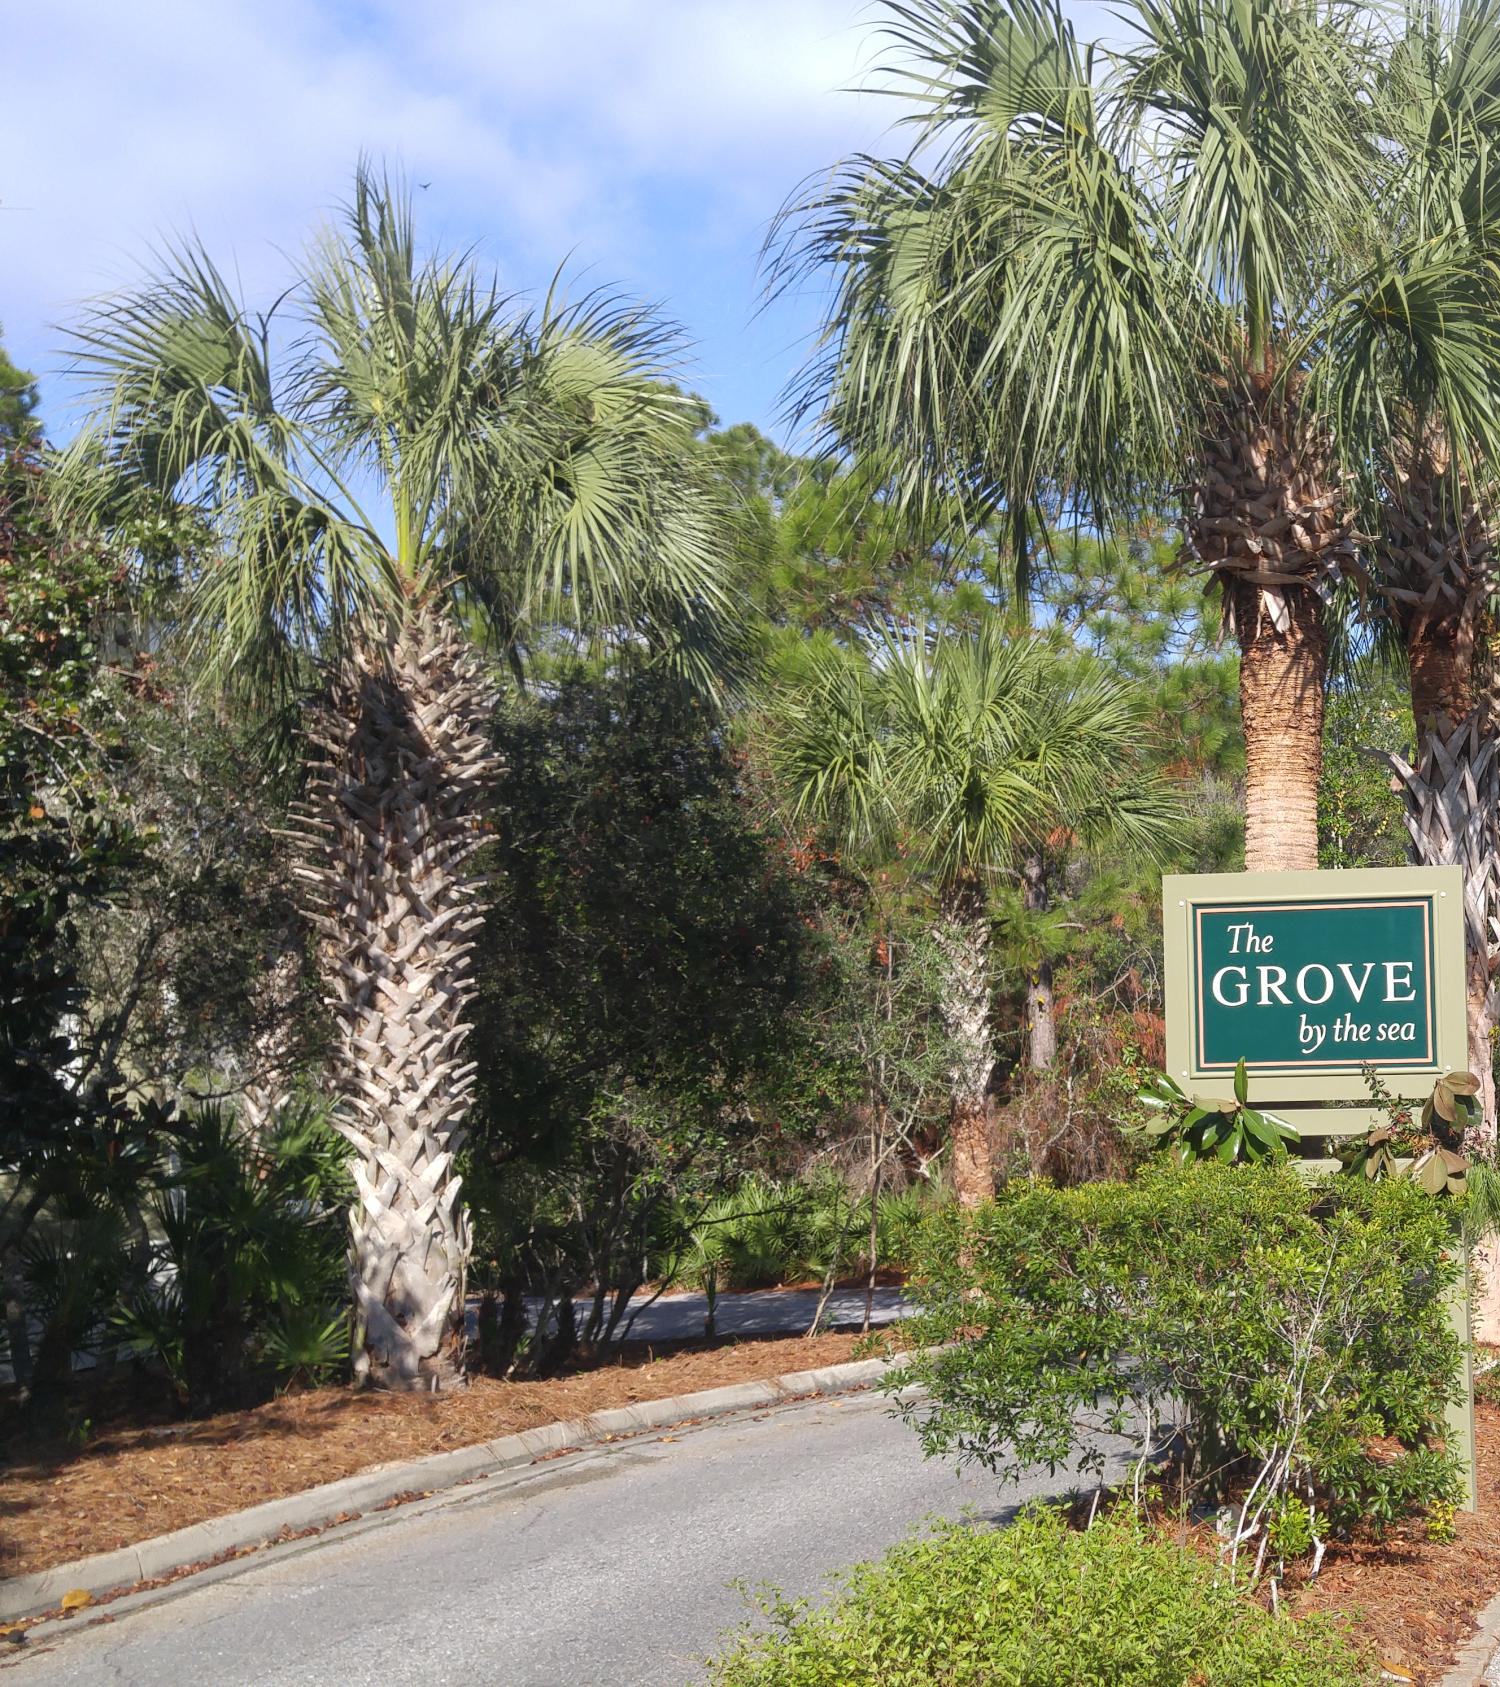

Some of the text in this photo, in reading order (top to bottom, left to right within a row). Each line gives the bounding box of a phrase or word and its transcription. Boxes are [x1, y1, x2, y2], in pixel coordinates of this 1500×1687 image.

[1227, 921, 1274, 954] The
[1212, 961, 1416, 1006] GROVE
[1299, 1012, 1416, 1053] by the sea
